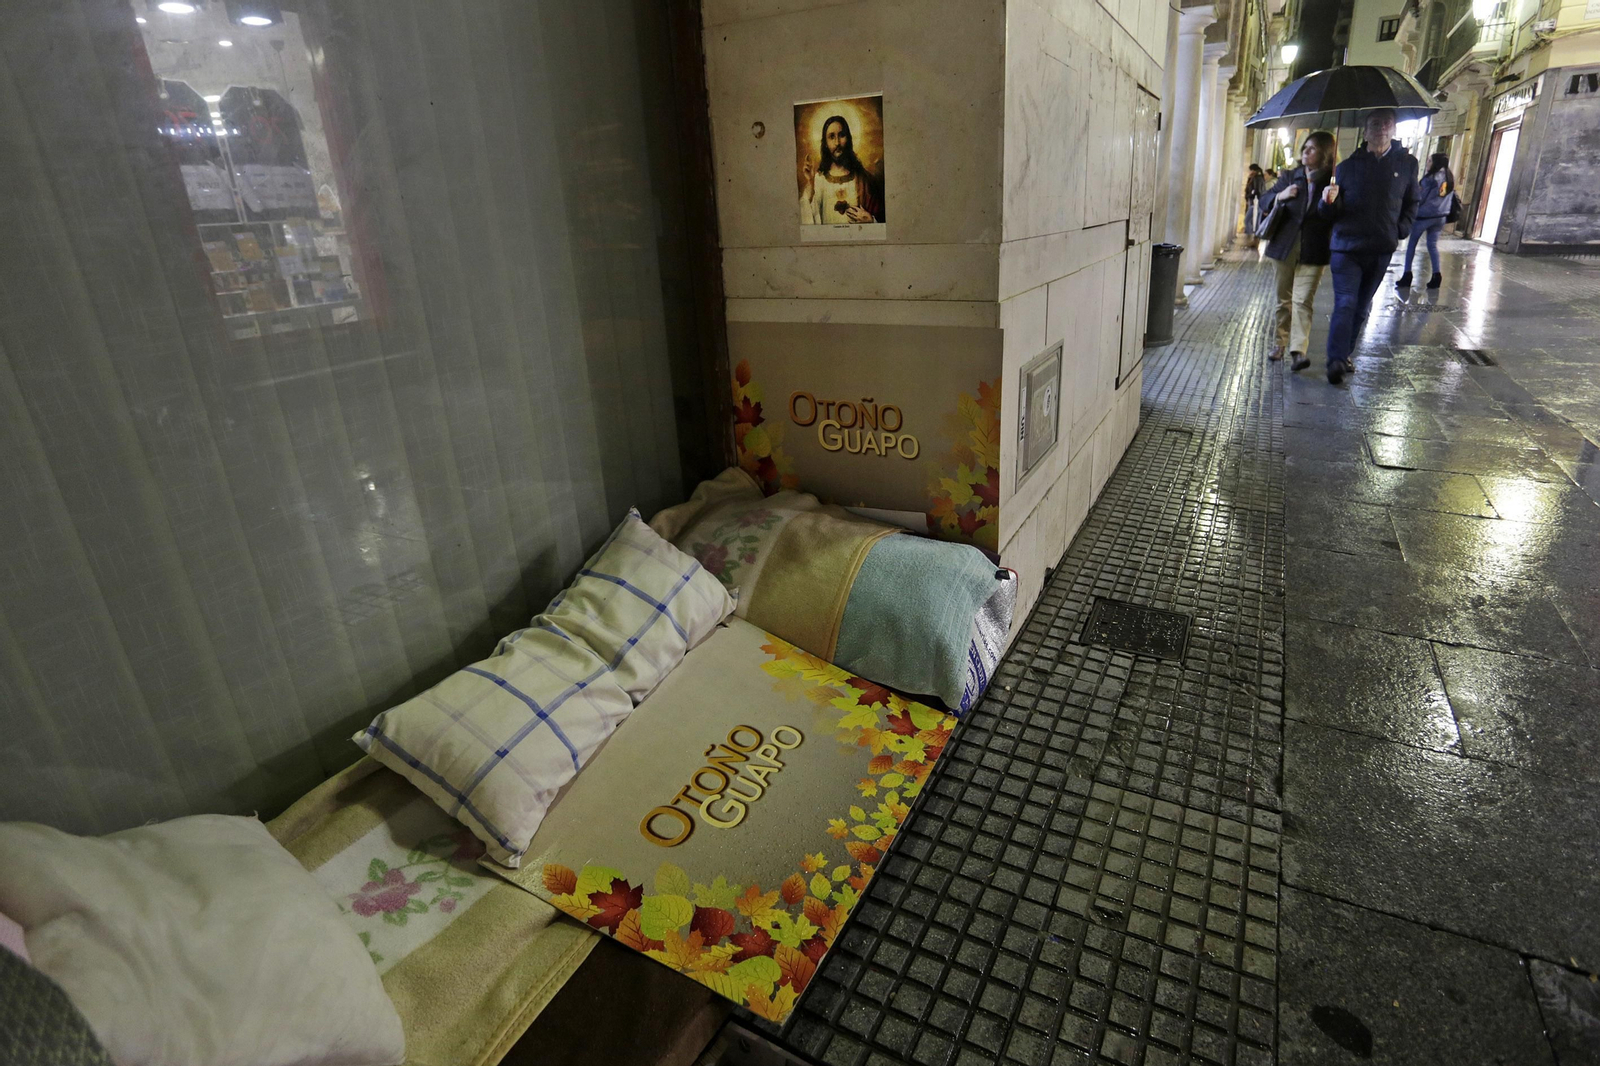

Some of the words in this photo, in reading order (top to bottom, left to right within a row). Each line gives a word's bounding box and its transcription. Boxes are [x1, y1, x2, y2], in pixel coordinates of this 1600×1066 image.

[788, 390, 903, 433] OTOÑO
[817, 419, 920, 460] GUAPO
[639, 724, 764, 848] OTOÑO
[699, 725, 805, 829] GUAPO
